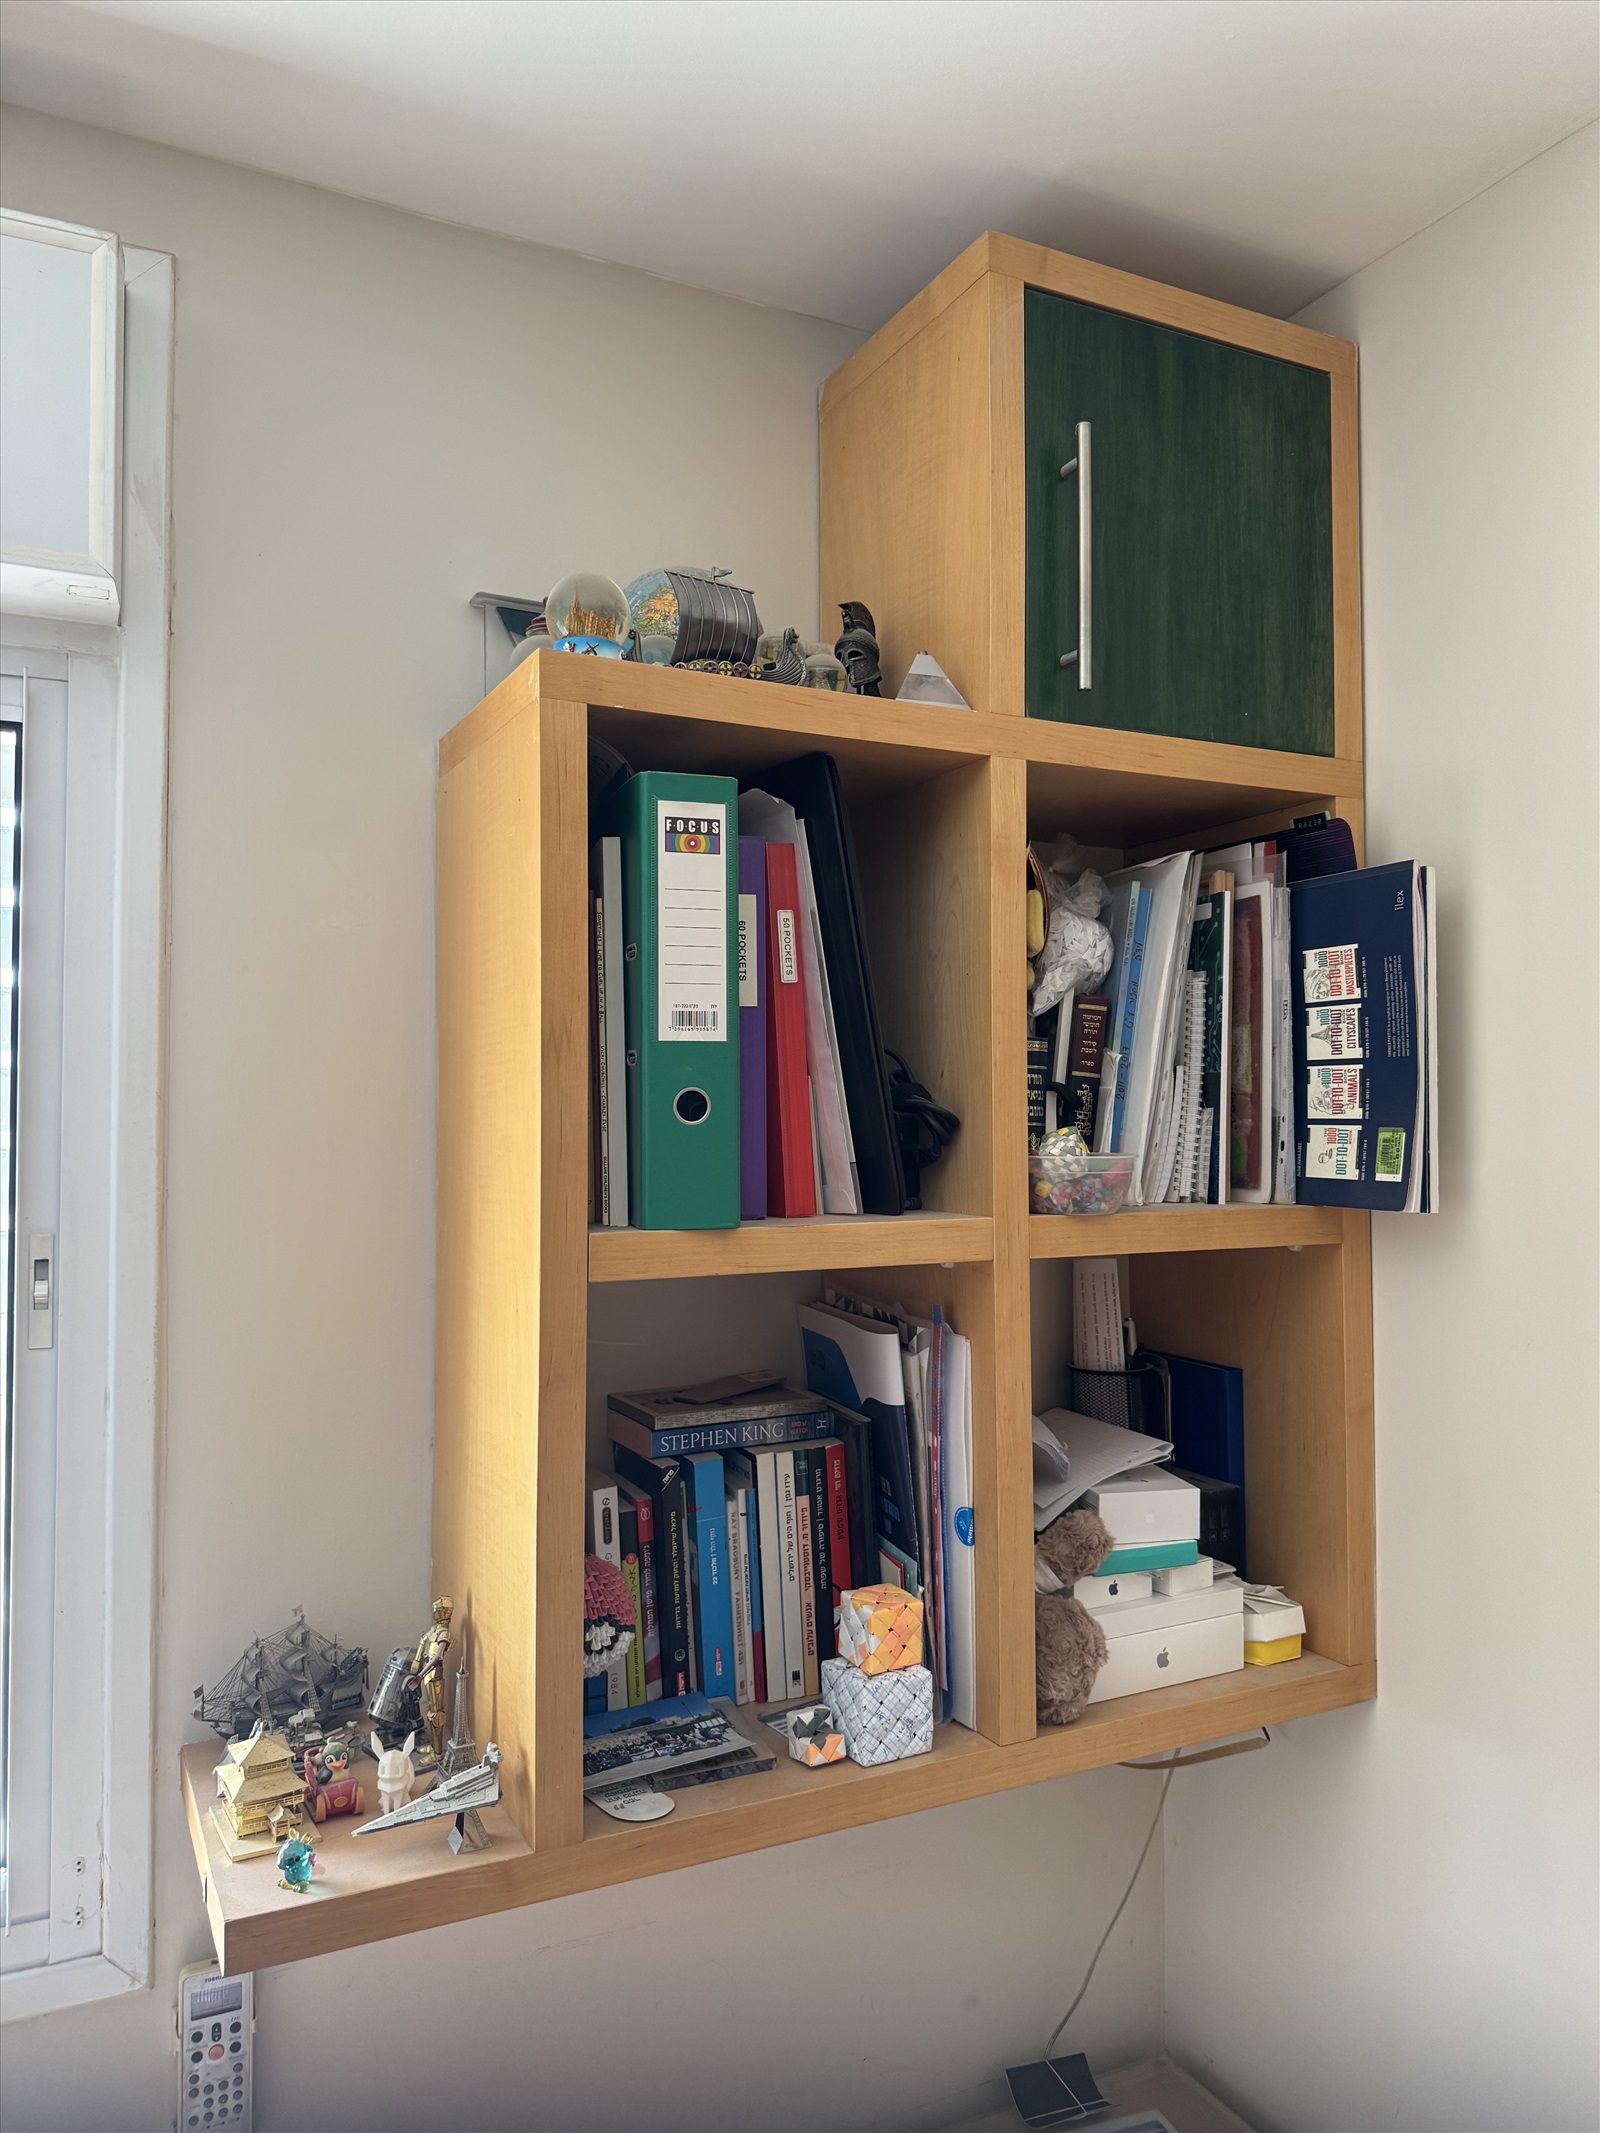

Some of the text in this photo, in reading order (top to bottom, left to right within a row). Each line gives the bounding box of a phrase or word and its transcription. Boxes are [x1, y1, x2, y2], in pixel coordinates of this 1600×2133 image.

[1298, 818, 1322, 829] RAZER
[1394, 890, 1404, 910] ilex
[738, 920, 747, 981] 60 POCKETS
[782, 917, 792, 976] 50 POCKETS
[1318, 951, 1328, 968] 1000
[1344, 949, 1355, 995] MASTERPIECES
[1320, 1009, 1330, 1025] 1000
[1346, 1008, 1356, 1049] CITYSCAPES
[1321, 1068, 1331, 1086] 1000
[1347, 1068, 1357, 1104] ANIMALS
[1327, 1128, 1337, 1145] 1000
[1335, 1128, 1349, 1175] DOT-TO-DOT
[660, 1422, 784, 1452] STEPHEN KING
[670, 1511, 678, 1532] מיכאל
[671, 1532, 679, 1559] שיינפלד
[731, 1533, 739, 1580] BRADBURY
[786, 1541, 793, 1552] של
[819, 1552, 826, 1565] של
[672, 1561, 680, 1579] החוק
[647, 1608, 655, 1638] המחלות
[734, 1591, 744, 1647] FAHRENHEIT
[806, 1629, 814, 1656] עלובים
